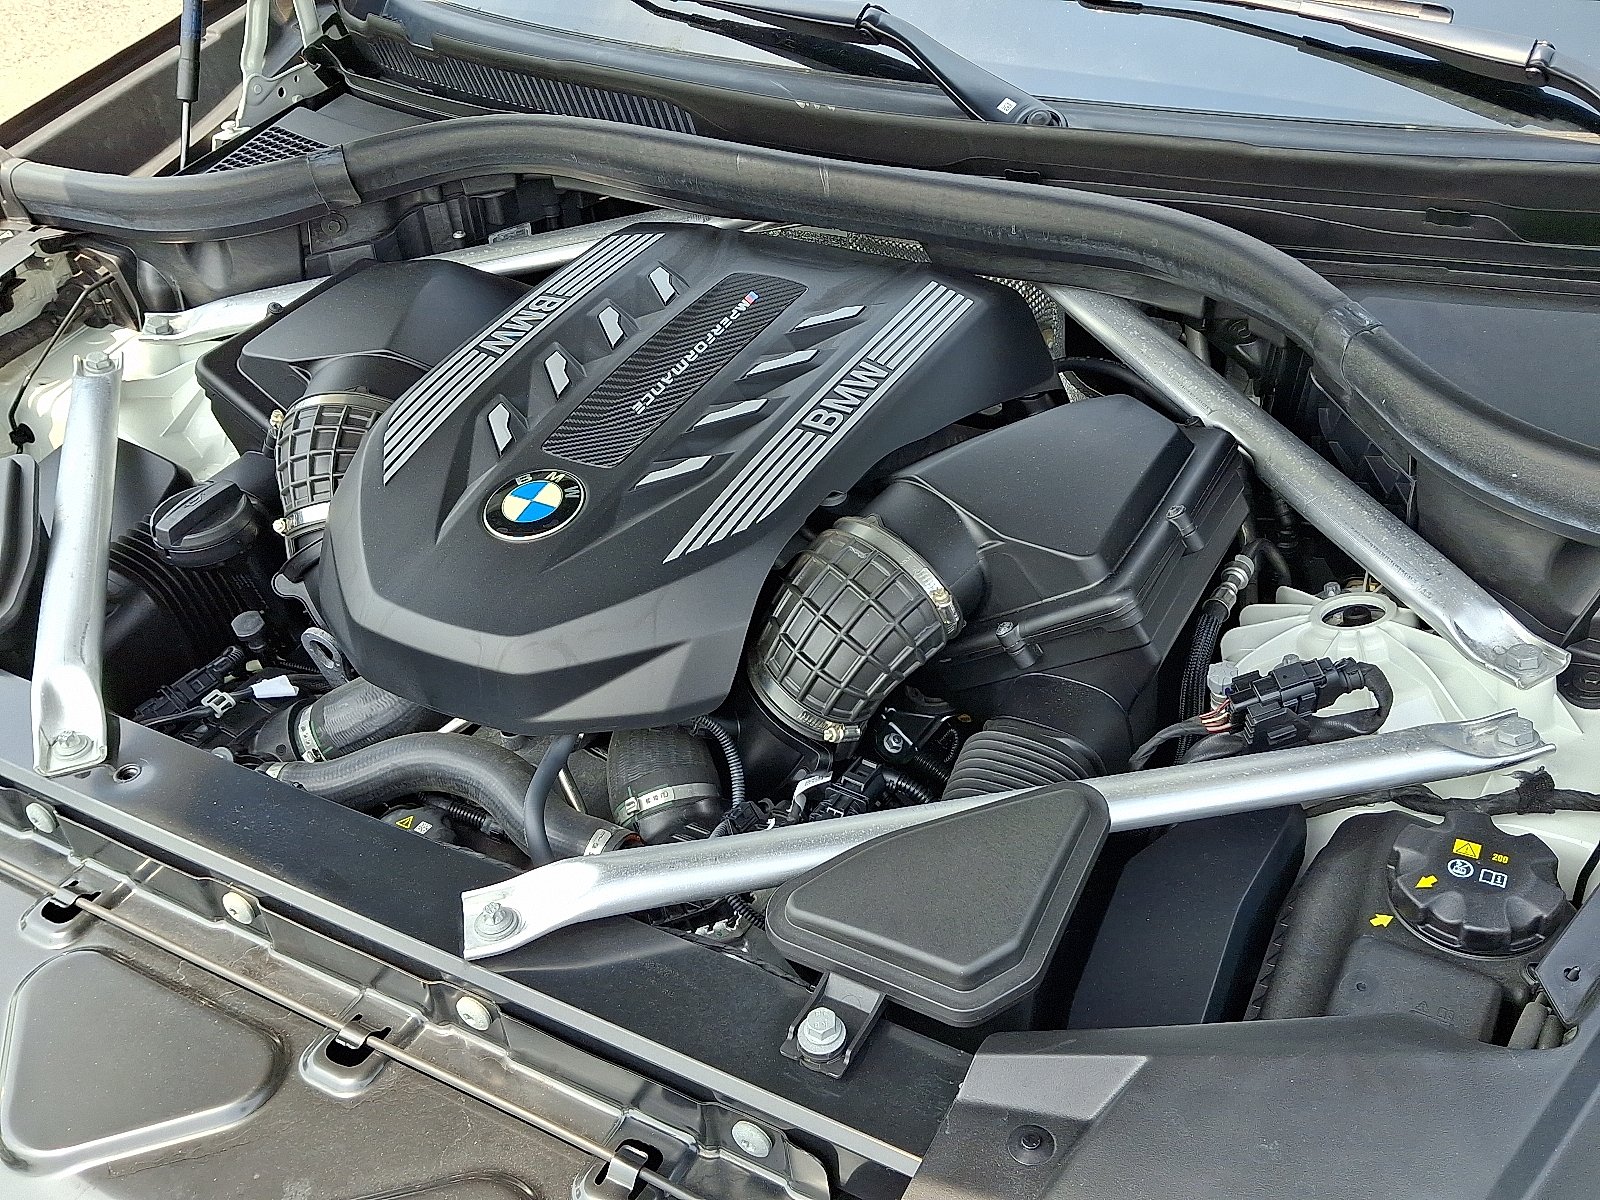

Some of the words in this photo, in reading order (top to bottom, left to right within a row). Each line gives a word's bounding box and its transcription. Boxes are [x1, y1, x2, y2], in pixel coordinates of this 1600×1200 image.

[479, 295, 567, 355] BMW
[801, 361, 889, 433] BMW
[515, 472, 580, 498] BMW
[1491, 853, 1509, 864] 200
